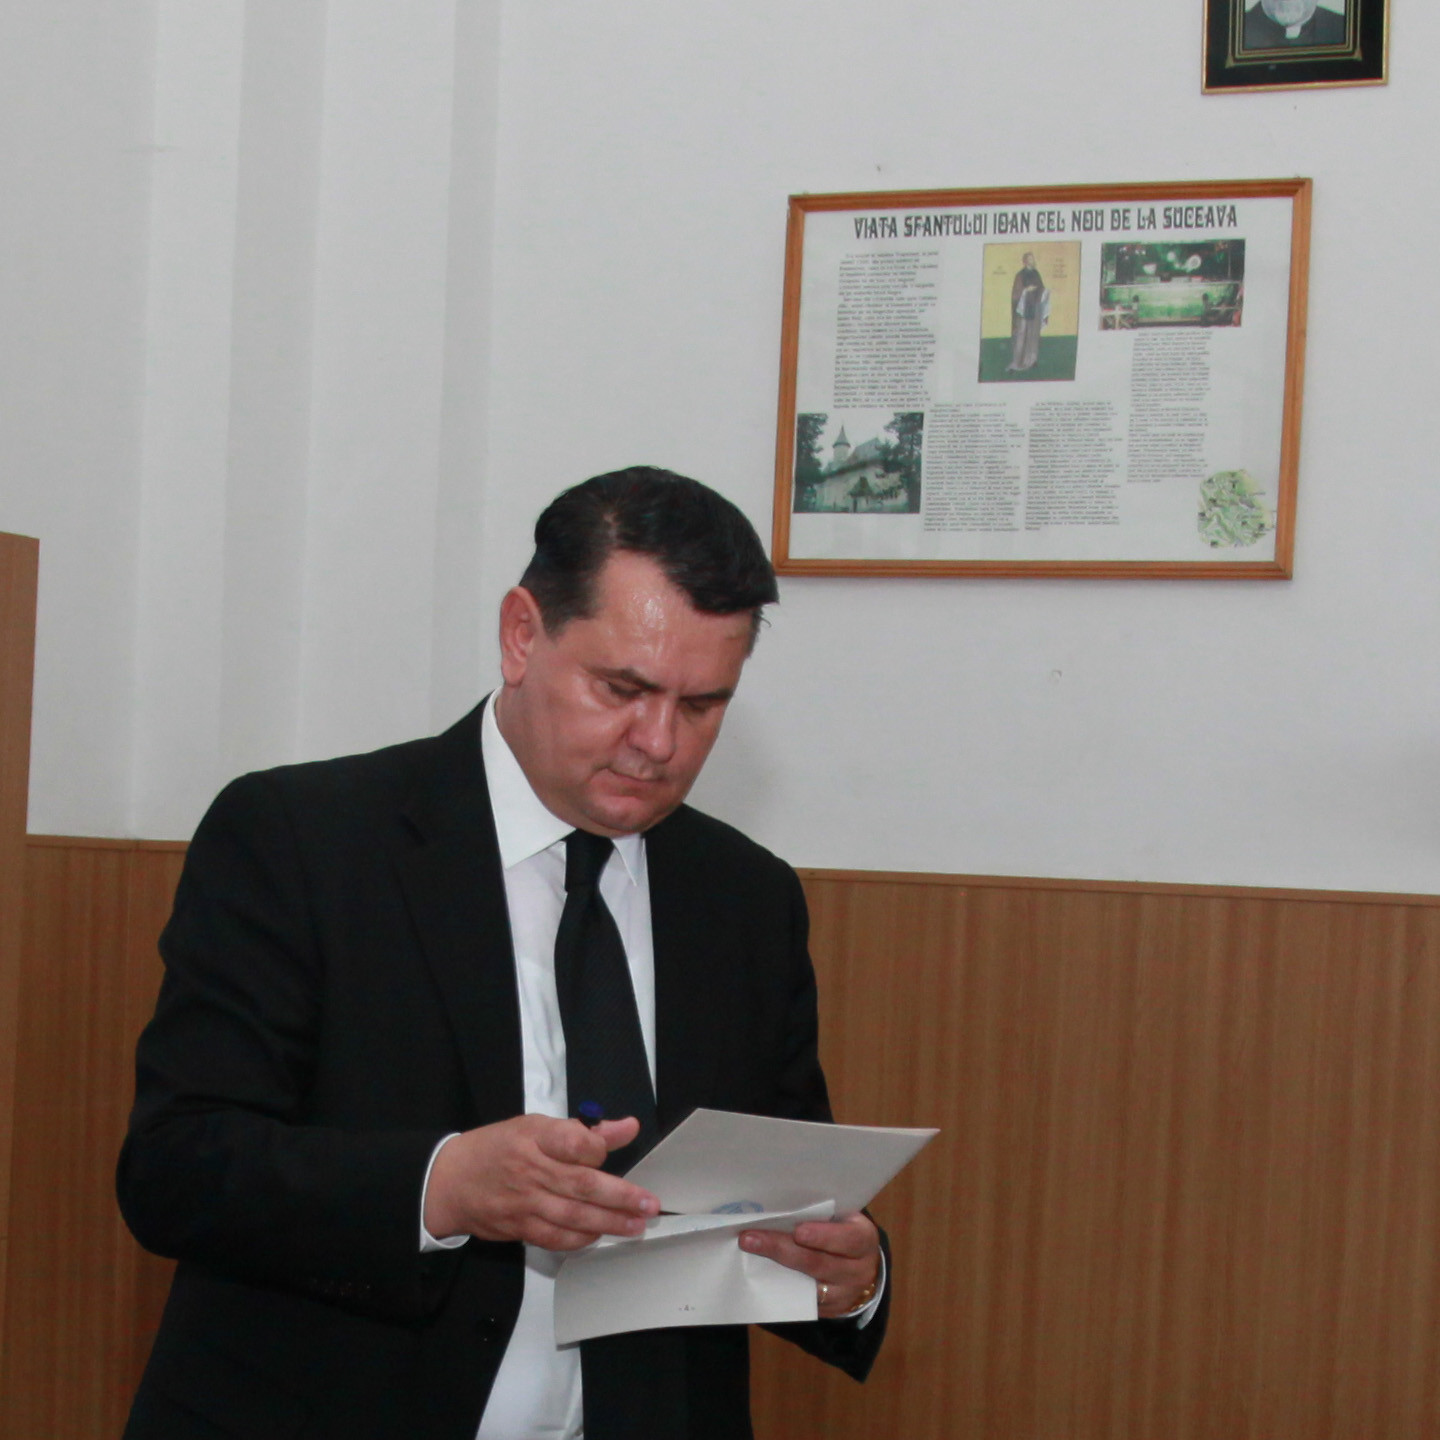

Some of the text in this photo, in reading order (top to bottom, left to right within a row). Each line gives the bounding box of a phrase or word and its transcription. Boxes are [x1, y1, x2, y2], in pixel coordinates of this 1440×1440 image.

[853, 204, 1238, 240] VIATA SFANTULUI IOAN CEL NOU DE LA SUCEAVA
